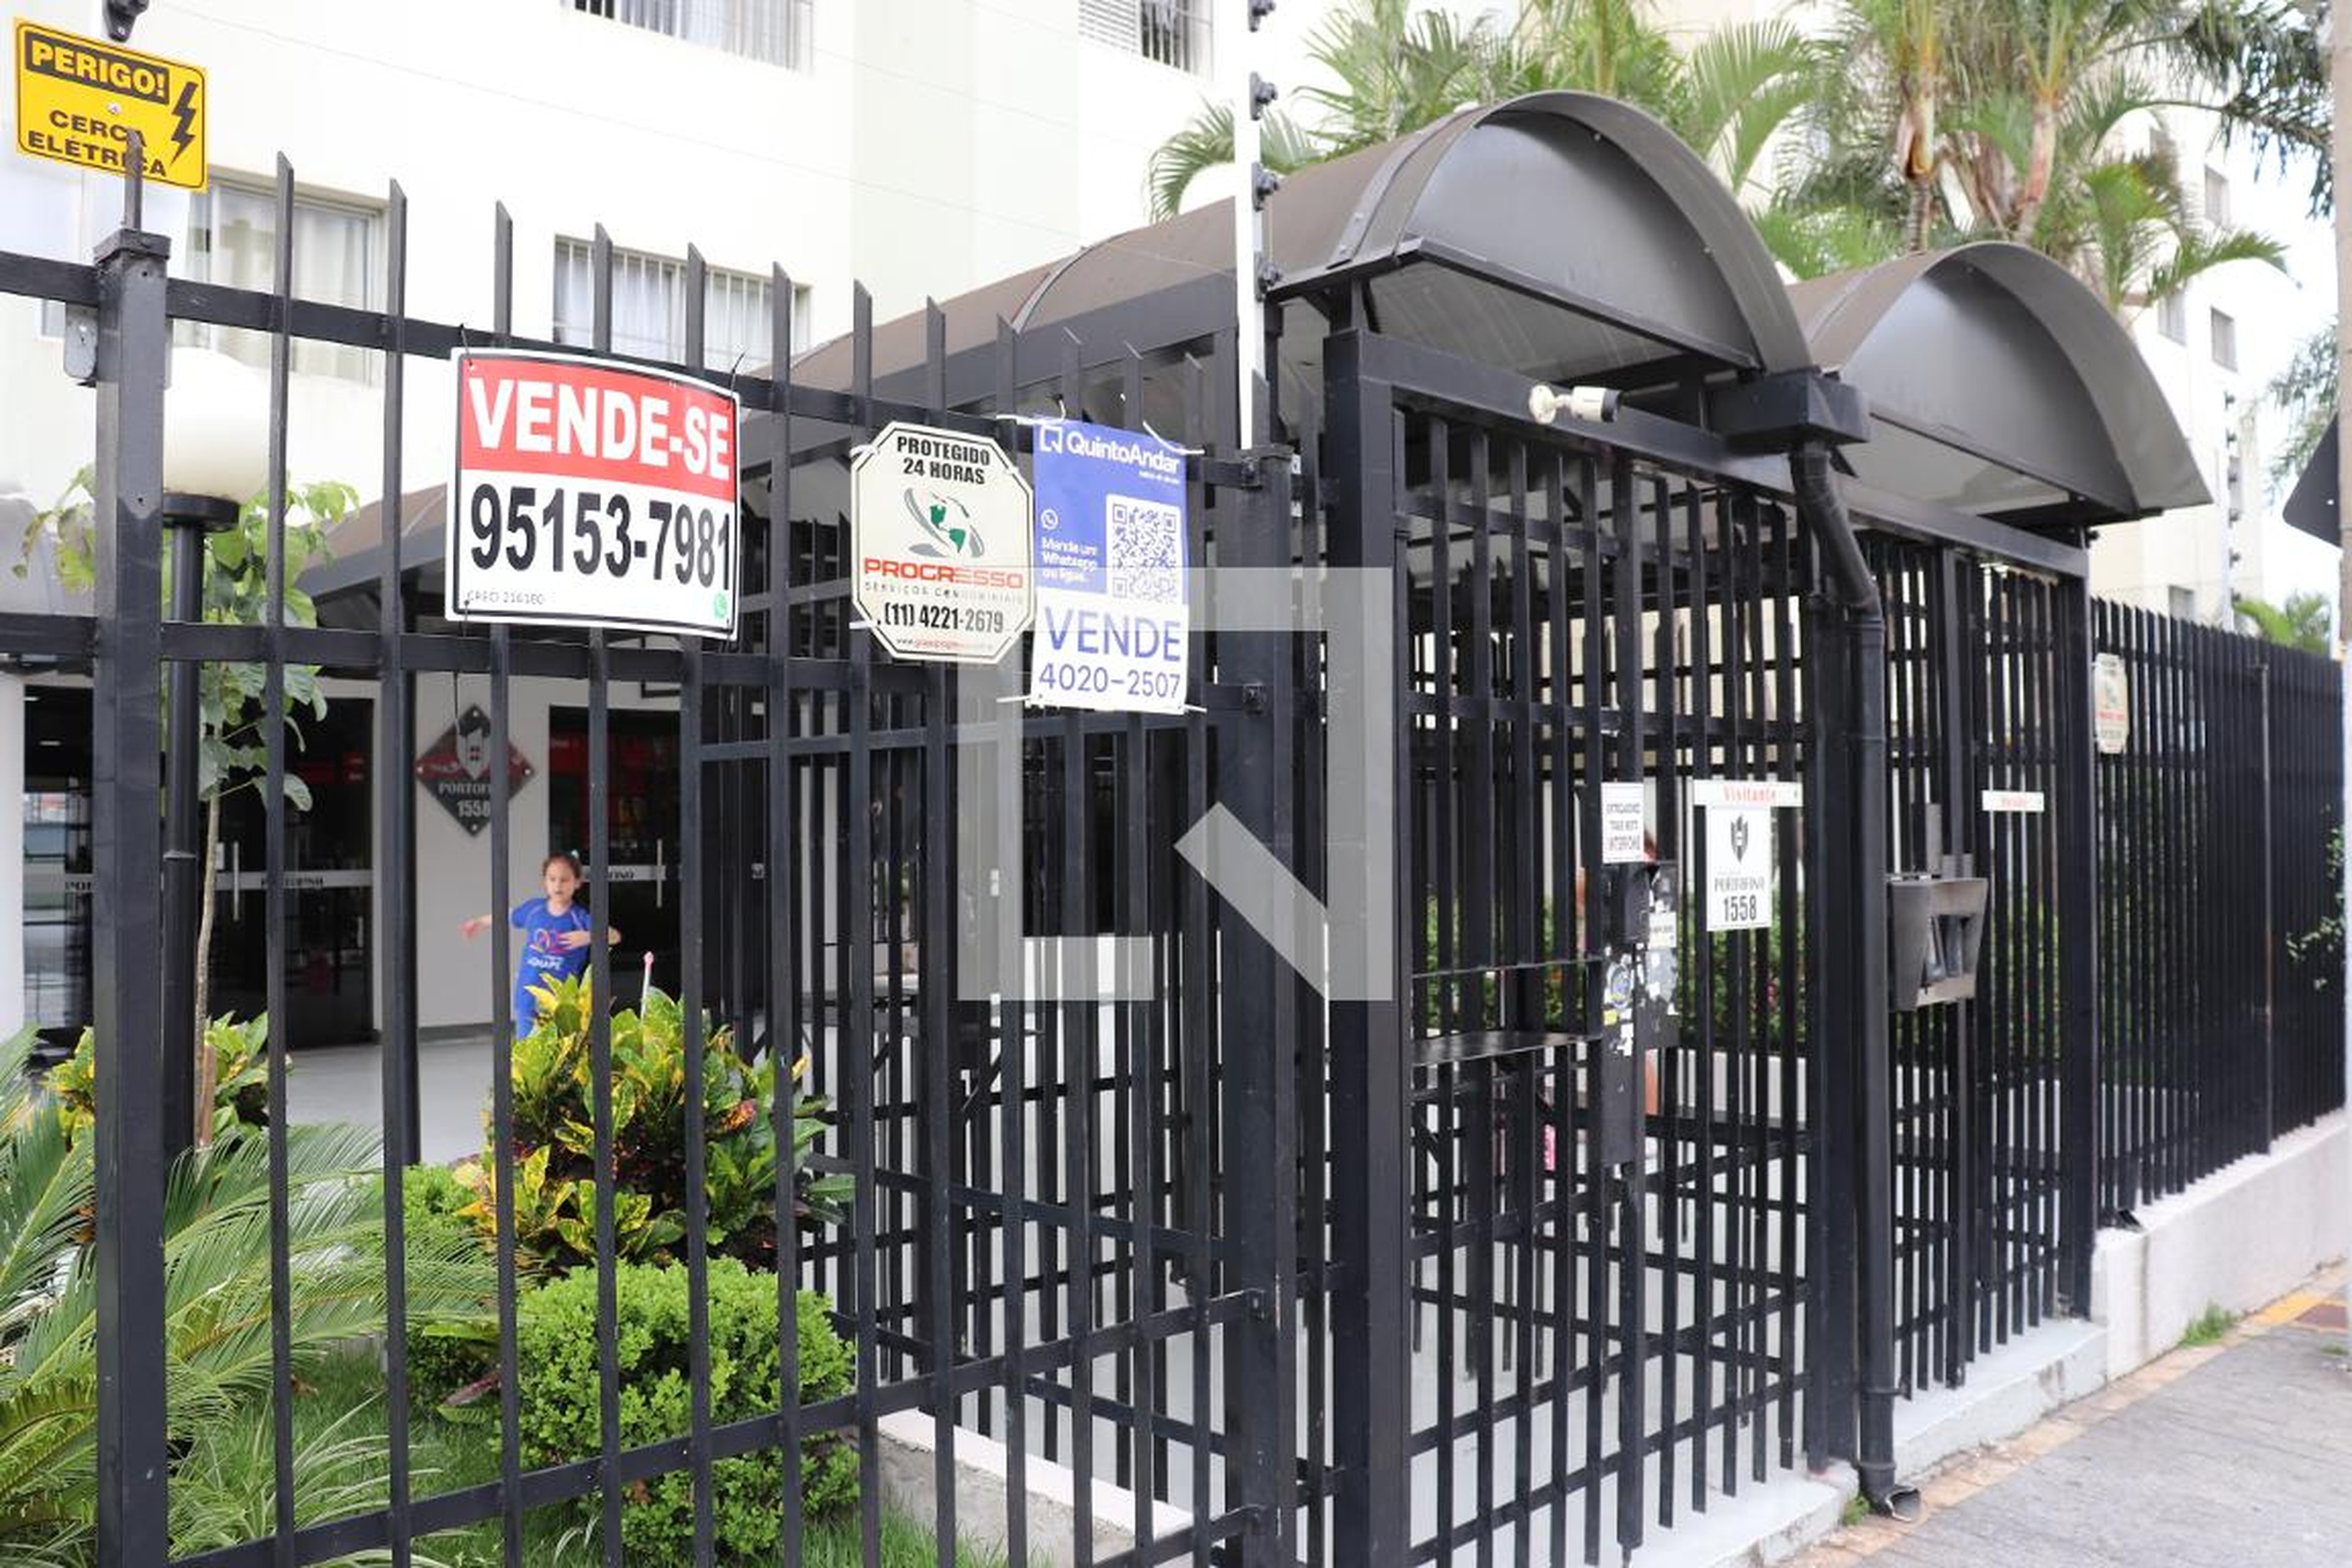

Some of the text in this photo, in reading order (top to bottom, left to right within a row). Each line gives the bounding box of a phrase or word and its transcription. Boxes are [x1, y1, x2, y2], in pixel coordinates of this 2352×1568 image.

[31, 40, 165, 98] PERIGO!
[28, 129, 167, 178] ELÉTRIA
[469, 378, 729, 481] VENDE-SE
[897, 435, 990, 466] PROTEGIDO
[1066, 431, 1180, 473] QuintoAndar
[903, 457, 985, 485] 24 HORAS
[470, 483, 730, 590] 95153-7981
[864, 557, 1023, 589] PROGRESSO
[884, 601, 1004, 634] (11) 4221-2679
[1044, 606, 1181, 662] VENDE
[1039, 663, 1181, 699] 4020-2507
[1724, 895, 1757, 922] 1558
